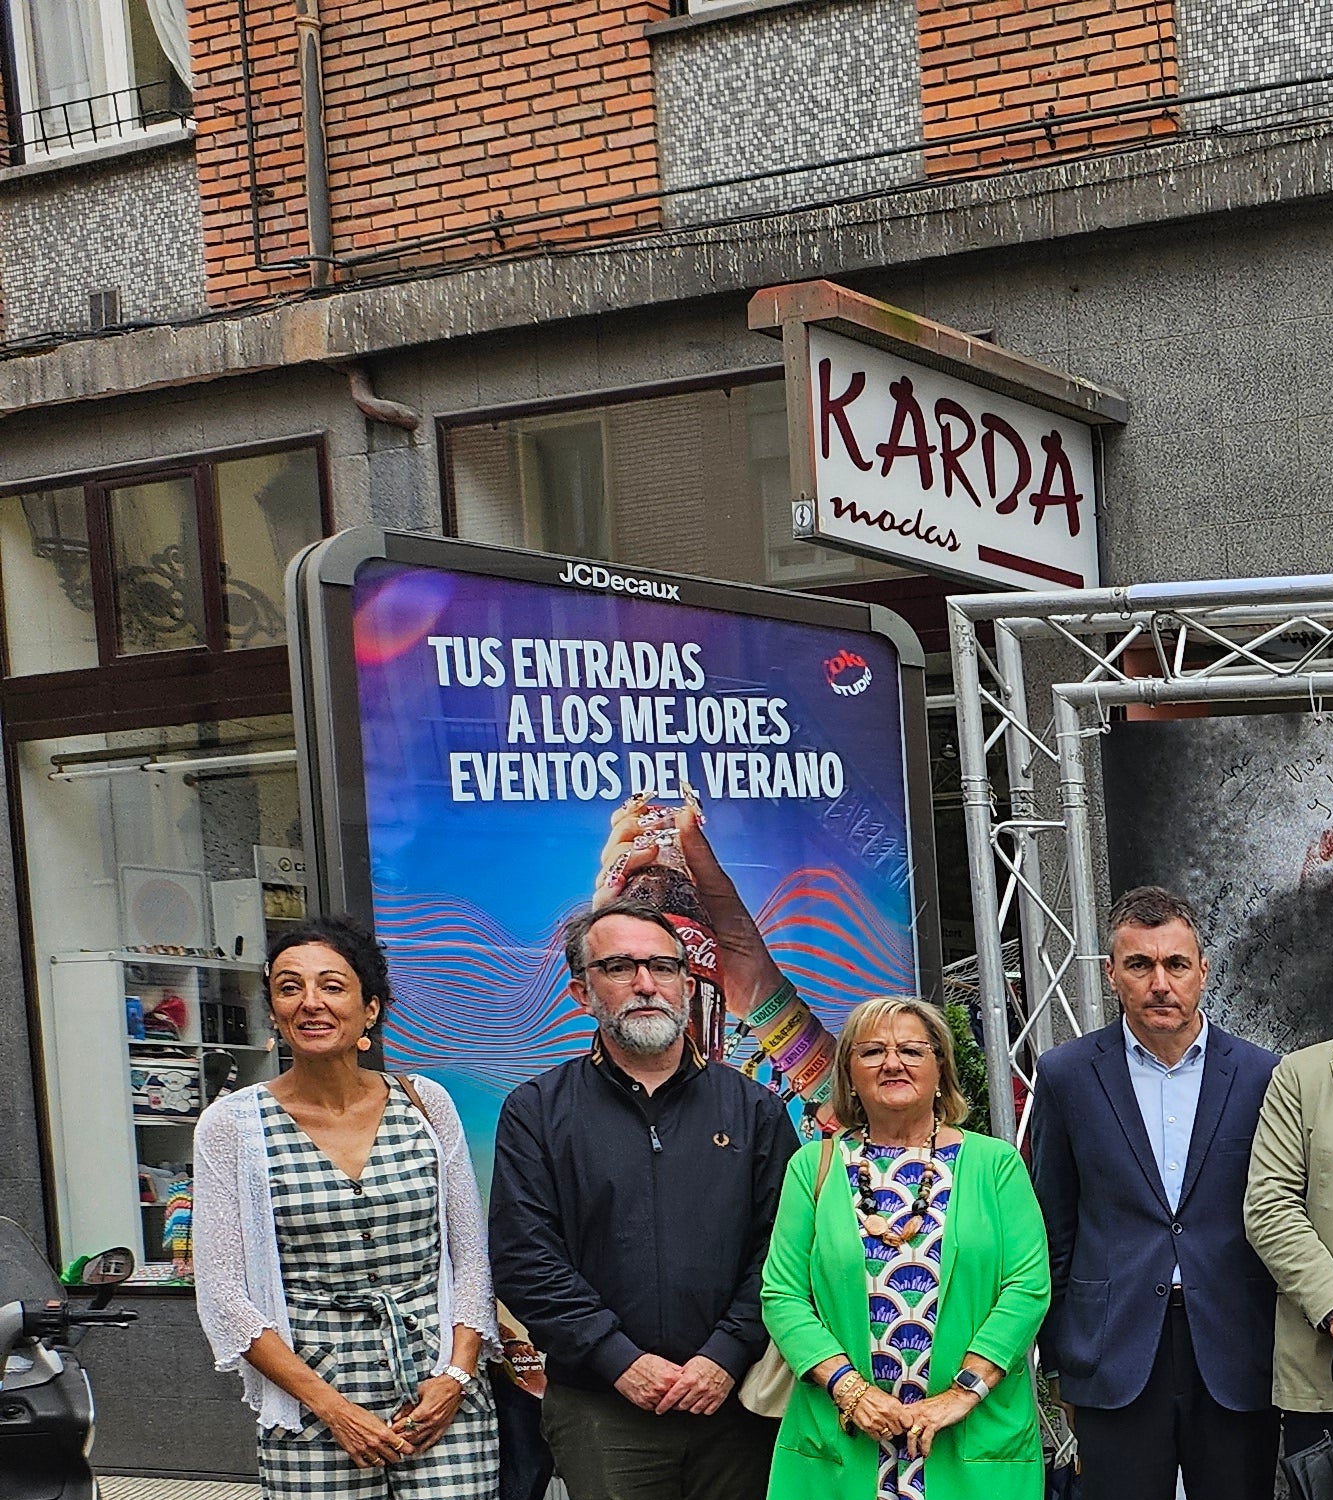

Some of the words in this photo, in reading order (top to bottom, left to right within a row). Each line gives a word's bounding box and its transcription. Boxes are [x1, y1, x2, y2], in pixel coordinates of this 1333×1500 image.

[817, 356, 1085, 538] KARDA
[829, 495, 963, 553] modas
[558, 561, 682, 602] JCDecaux
[427, 635, 506, 689] TUS
[510, 638, 705, 691] ENTRADAS
[507, 694, 531, 744] A
[541, 694, 613, 745] LOS
[619, 695, 791, 745] MEJORES
[449, 751, 622, 802] EVENTOS
[629, 751, 700, 800] DEL
[700, 751, 845, 800] VERANO
